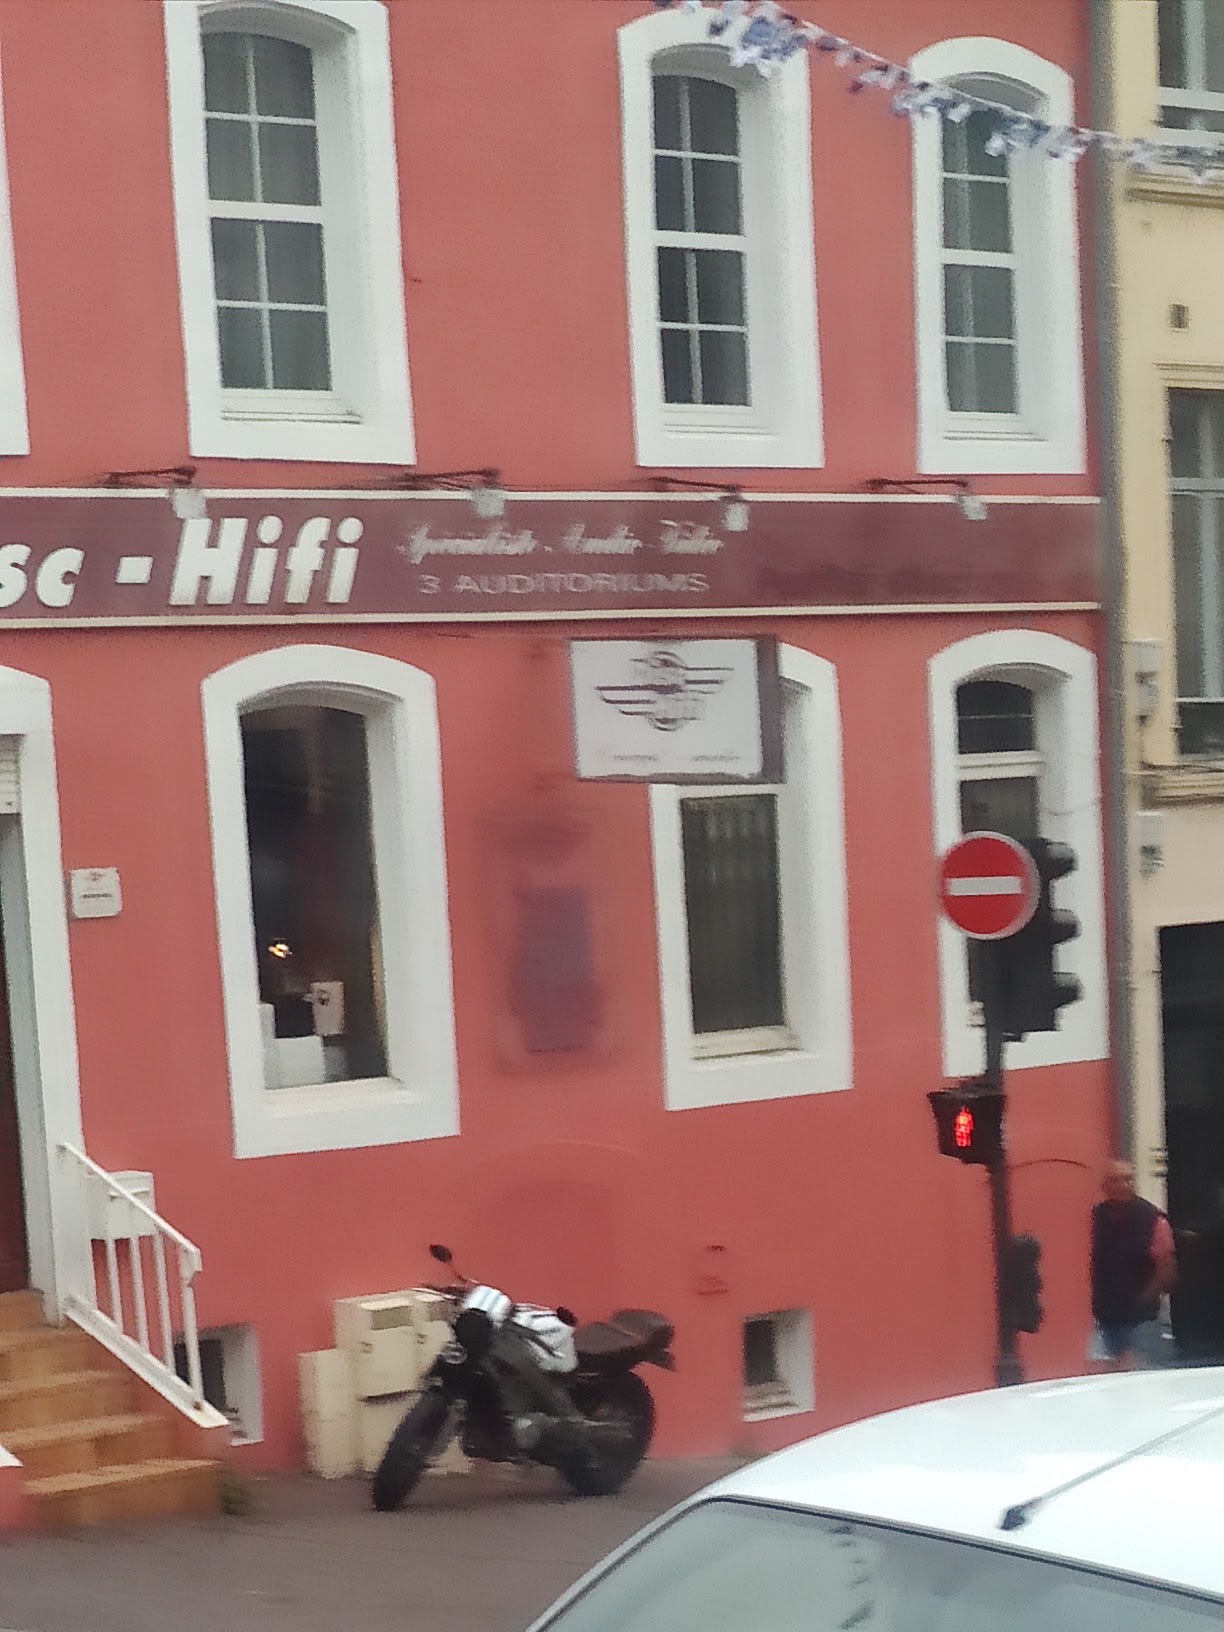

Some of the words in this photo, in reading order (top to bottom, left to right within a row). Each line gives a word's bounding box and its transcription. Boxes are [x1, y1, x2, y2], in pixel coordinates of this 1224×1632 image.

[168, 514, 365, 606] Hifi
[419, 573, 441, 595] 3
[453, 572, 709, 595] AUDITORIUMS
